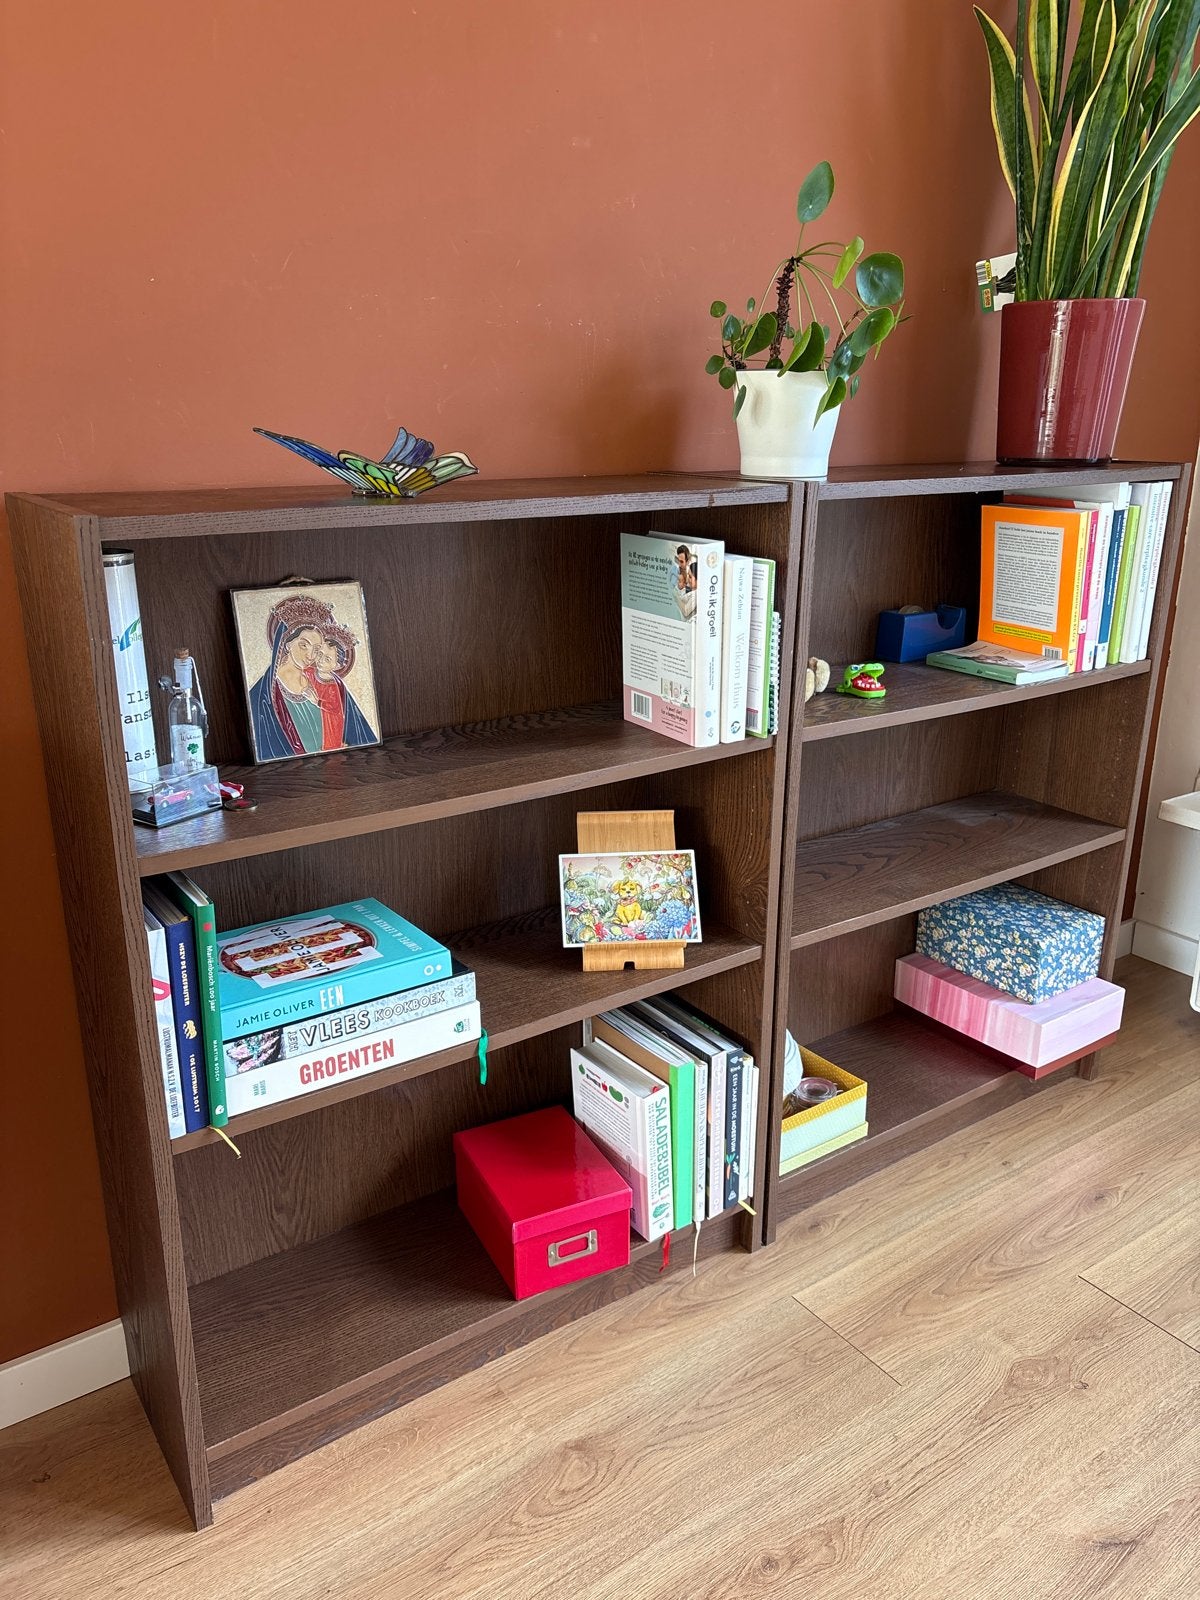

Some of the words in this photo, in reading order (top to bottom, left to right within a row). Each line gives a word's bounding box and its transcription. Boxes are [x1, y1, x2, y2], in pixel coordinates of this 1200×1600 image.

[737, 567, 745, 592] Najwa
[708, 599, 717, 609] ik
[737, 593, 745, 620] Zebian
[707, 610, 716, 638] groei!
[734, 632, 745, 679] Welkom
[732, 681, 744, 709] thuis
[120, 709, 152, 724] ans
[178, 942, 186, 960] NSZV
[297, 949, 330, 972] JAMIE
[181, 961, 187, 970] DE
[206, 945, 216, 986] Mariënbosch
[181, 970, 190, 1006] LOEFBIJTER
[319, 984, 345, 1011] EEN
[236, 1011, 271, 1029] JAMIE
[273, 1000, 315, 1018] OLIVER
[287, 1030, 299, 1053] HET
[300, 1009, 371, 1047] VLEES
[374, 990, 446, 1022] KOOKBOEK
[299, 1038, 395, 1085] GROENTEN
[190, 1066, 199, 1096] LUSTRUM
[731, 1110, 737, 1120] DE
[713, 1146, 720, 1156] DE
